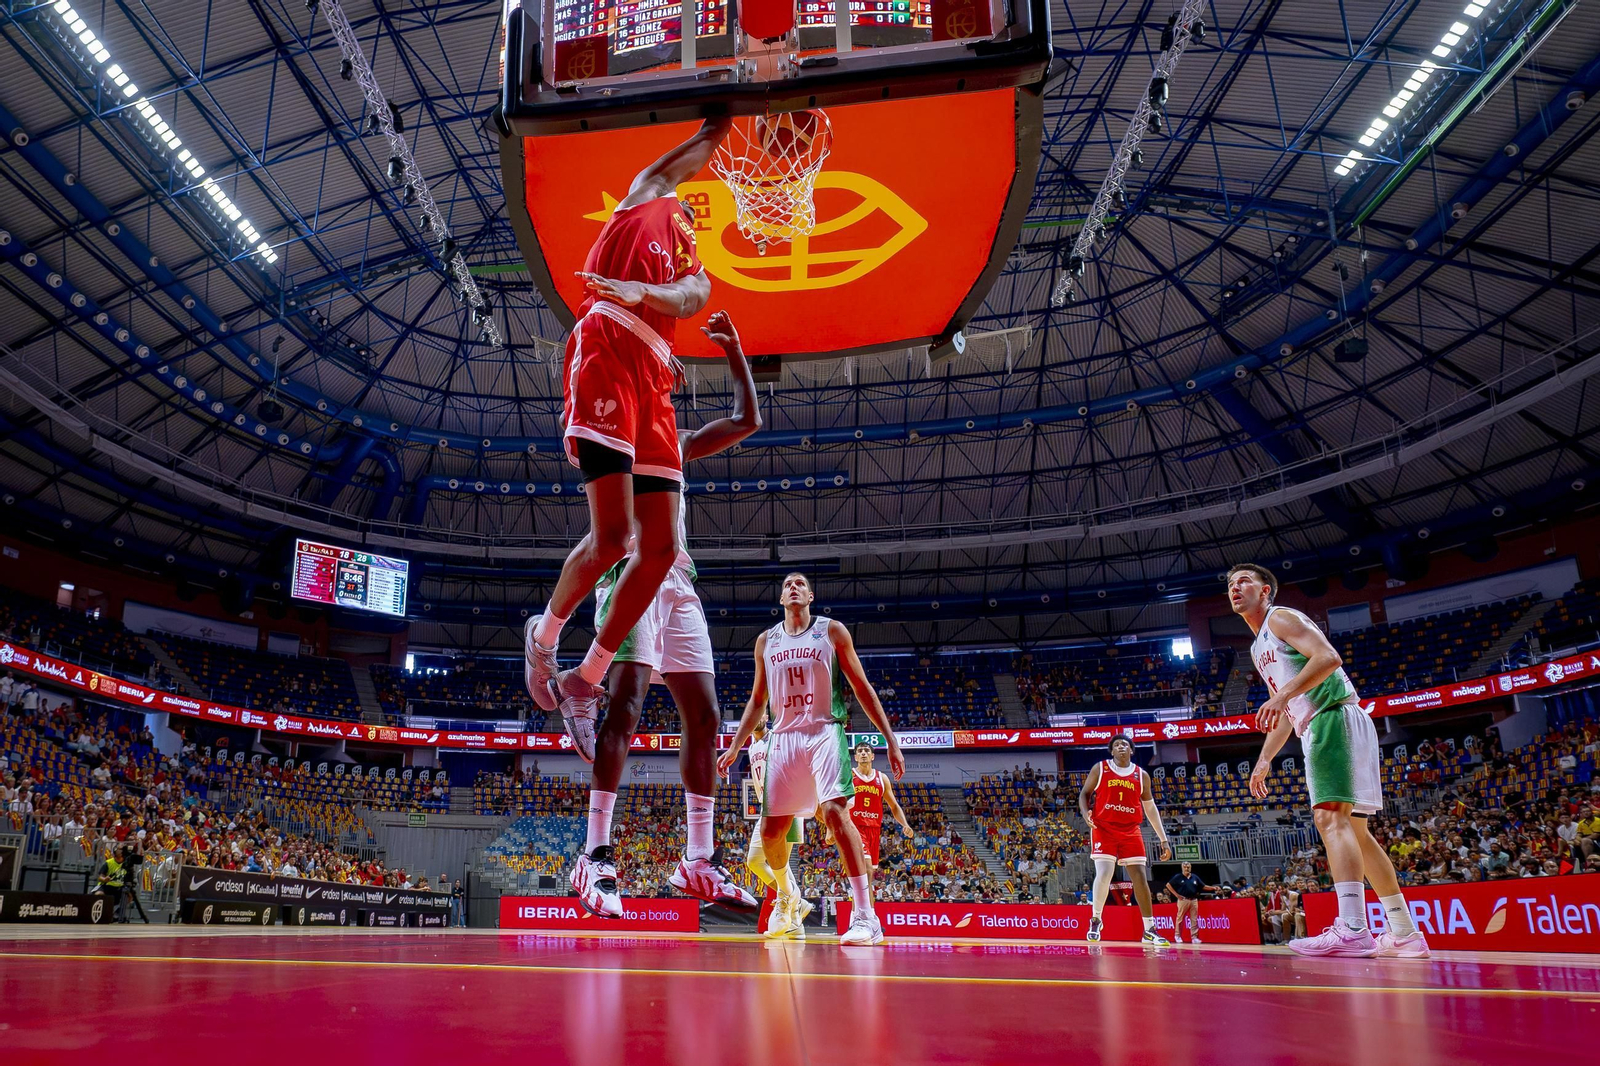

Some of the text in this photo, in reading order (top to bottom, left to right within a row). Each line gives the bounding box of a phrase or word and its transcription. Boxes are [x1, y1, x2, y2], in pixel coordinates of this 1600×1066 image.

[344, 572, 362, 583] 8:46
[770, 648, 822, 666] PORTUGAL
[788, 666, 805, 686] 14
[119, 685, 145, 698] IBERIA
[163, 696, 200, 710] azulmarino
[1388, 691, 1440, 706] azulmarino
[862, 735, 879, 746] 28
[854, 786, 880, 796] ESPAÑA
[1108, 779, 1134, 791] ESPAÑA
[864, 798, 870, 807] 5
[1119, 792, 1123, 801] 1
[853, 811, 879, 819] endesa
[1105, 804, 1135, 814] endesa
[215, 880, 243, 892] endesa
[322, 889, 340, 900] endesa
[19, 903, 78, 918] #LaFamilia
[518, 907, 578, 918] IBERIA
[640, 912, 646, 920] a
[649, 910, 679, 921] bordo
[887, 914, 1078, 929] IBERIA Talento a bordo
[1212, 914, 1230, 930] bordo
